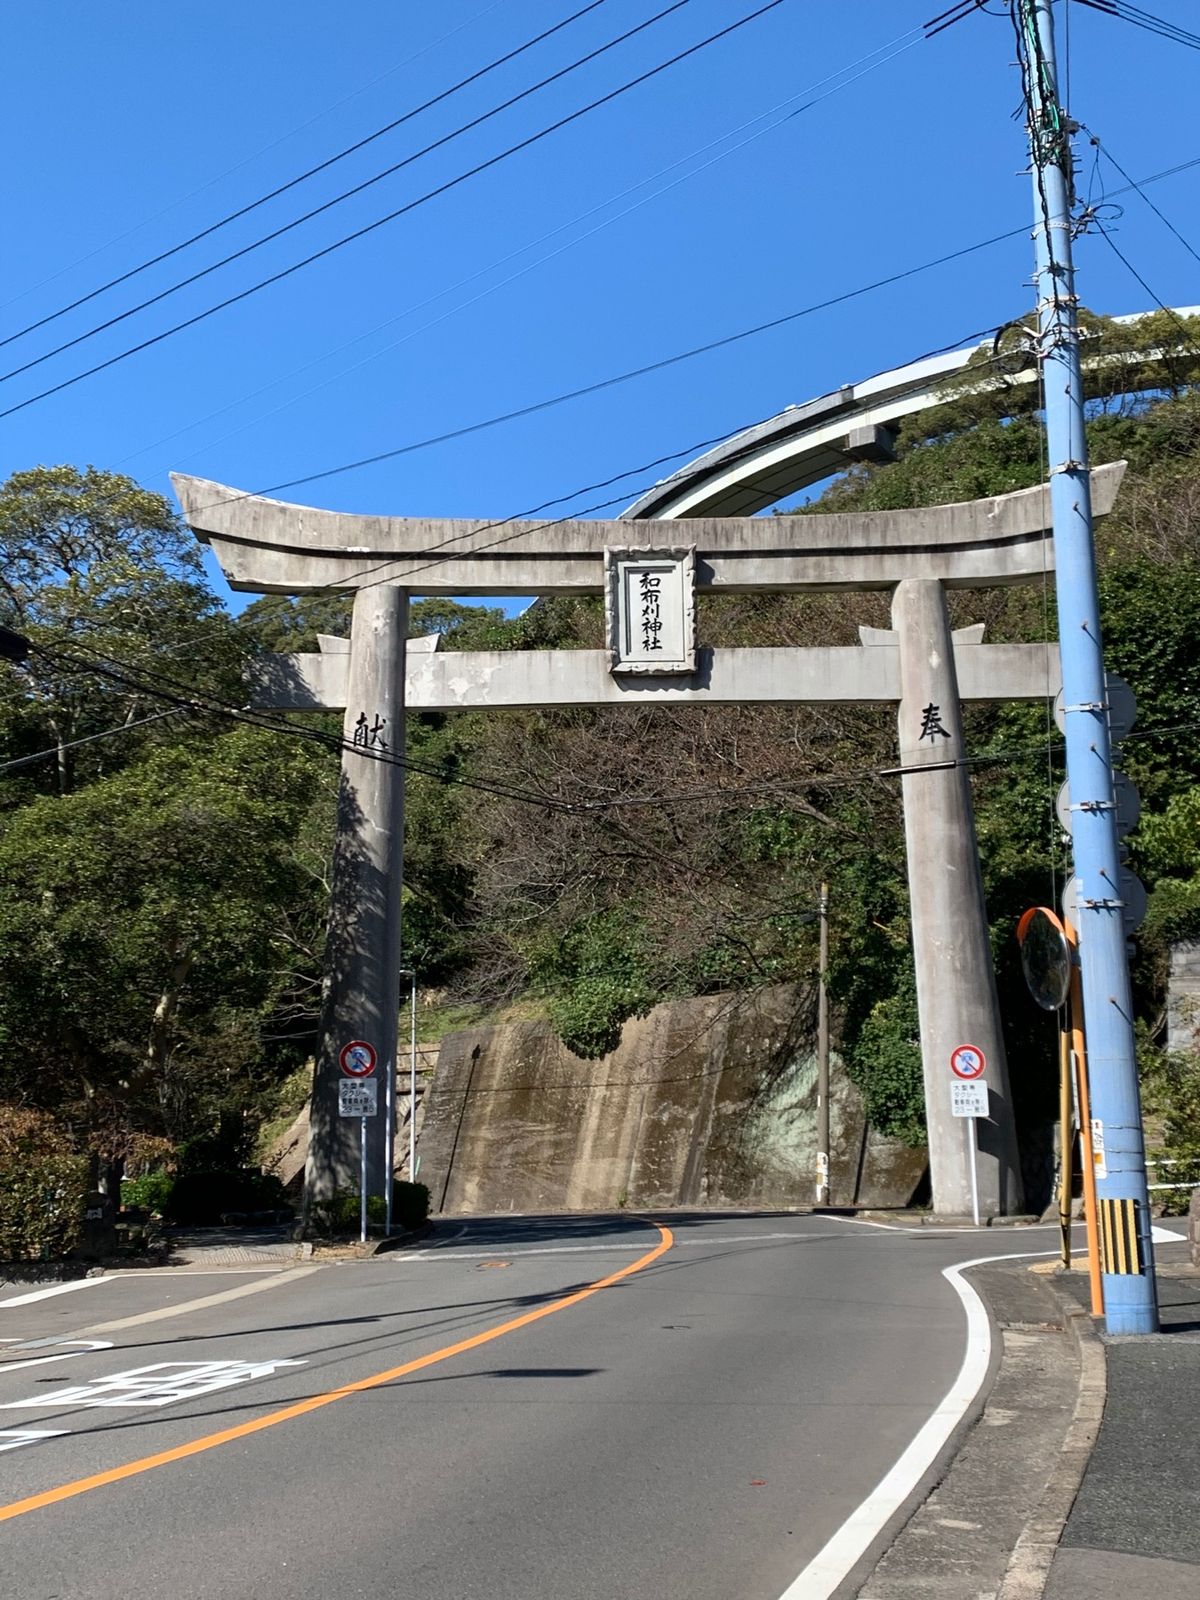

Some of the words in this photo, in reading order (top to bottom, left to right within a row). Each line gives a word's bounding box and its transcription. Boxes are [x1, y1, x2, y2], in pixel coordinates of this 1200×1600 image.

[639, 571, 663, 652] 和布刈神社
[918, 702, 952, 745] 奉
